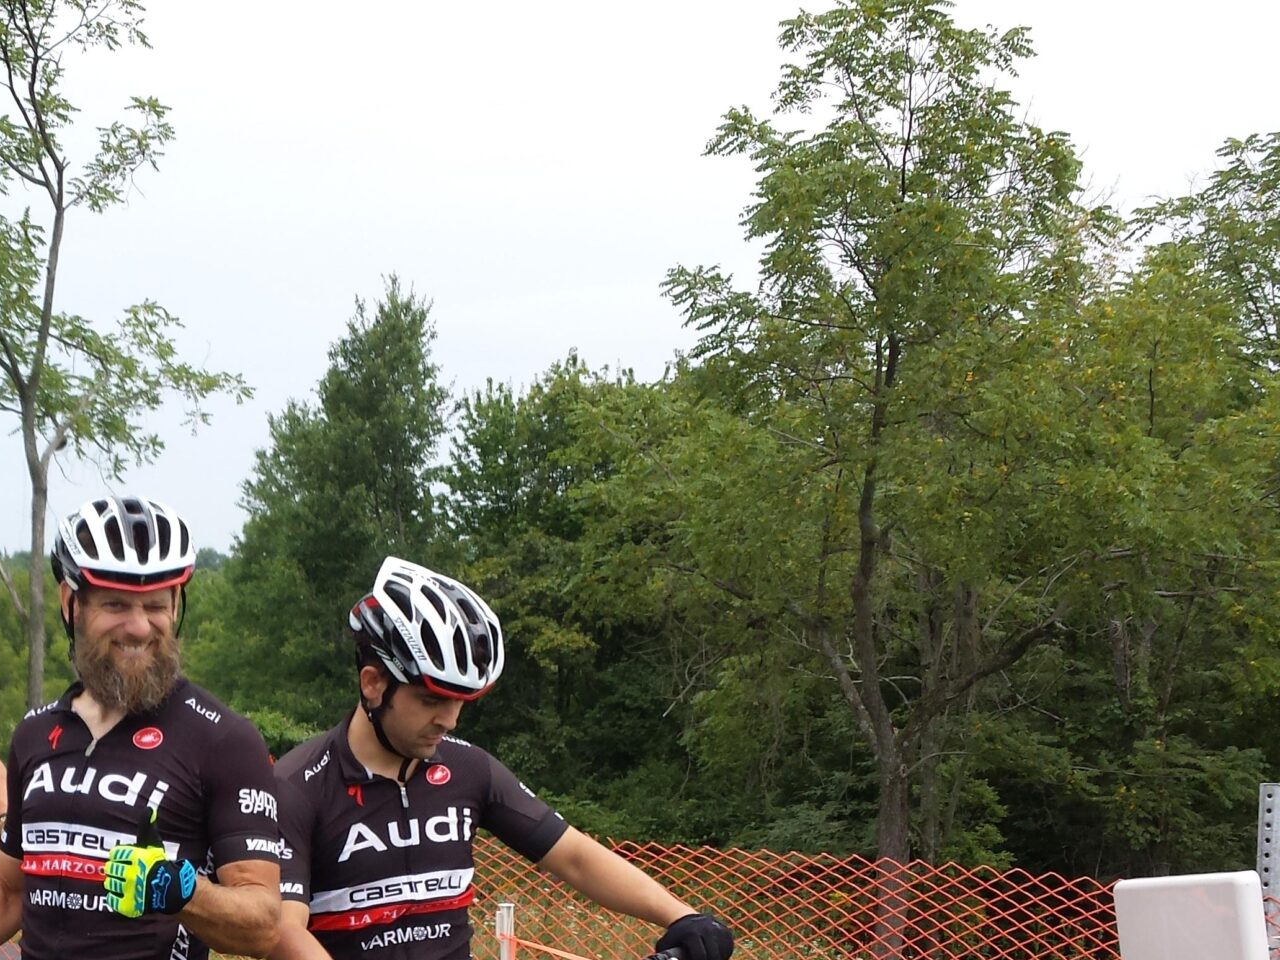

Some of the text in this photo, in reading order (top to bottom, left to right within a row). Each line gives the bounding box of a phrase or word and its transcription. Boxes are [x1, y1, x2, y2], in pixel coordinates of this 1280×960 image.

[23, 699, 59, 720] Aud
[184, 697, 222, 725] Audi
[304, 750, 331, 782] Audi
[23, 761, 170, 809] Audi
[26, 829, 120, 852] CASTEL
[337, 806, 473, 863] Audi
[41, 859, 106, 876] MARZOC
